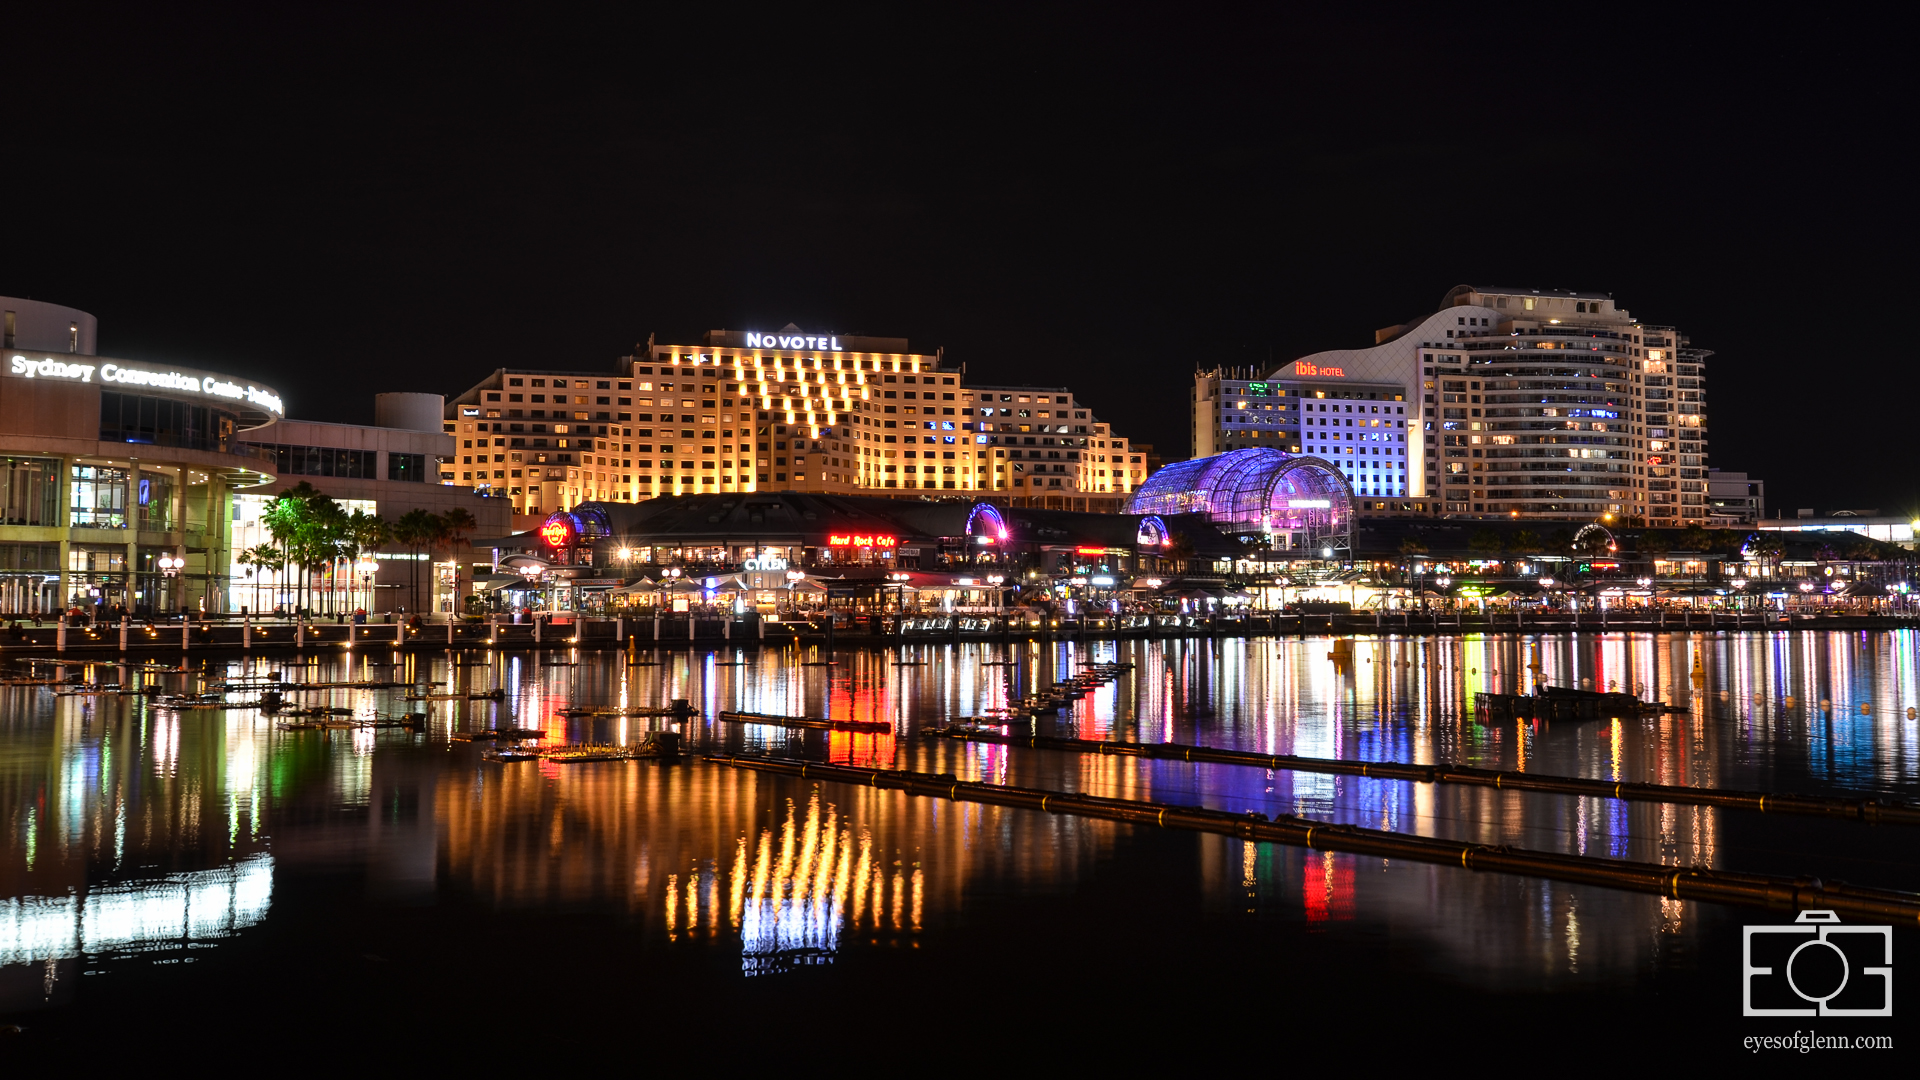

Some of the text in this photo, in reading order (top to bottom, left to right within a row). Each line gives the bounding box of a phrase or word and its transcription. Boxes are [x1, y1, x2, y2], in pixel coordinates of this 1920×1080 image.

[747, 332, 843, 351] NOVOTEL
[11, 355, 96, 382] Sydney
[100, 363, 201, 392] Convention
[1295, 361, 1345, 377] ibis HOTEL
[830, 535, 895, 547] Hard Rock Cafe
